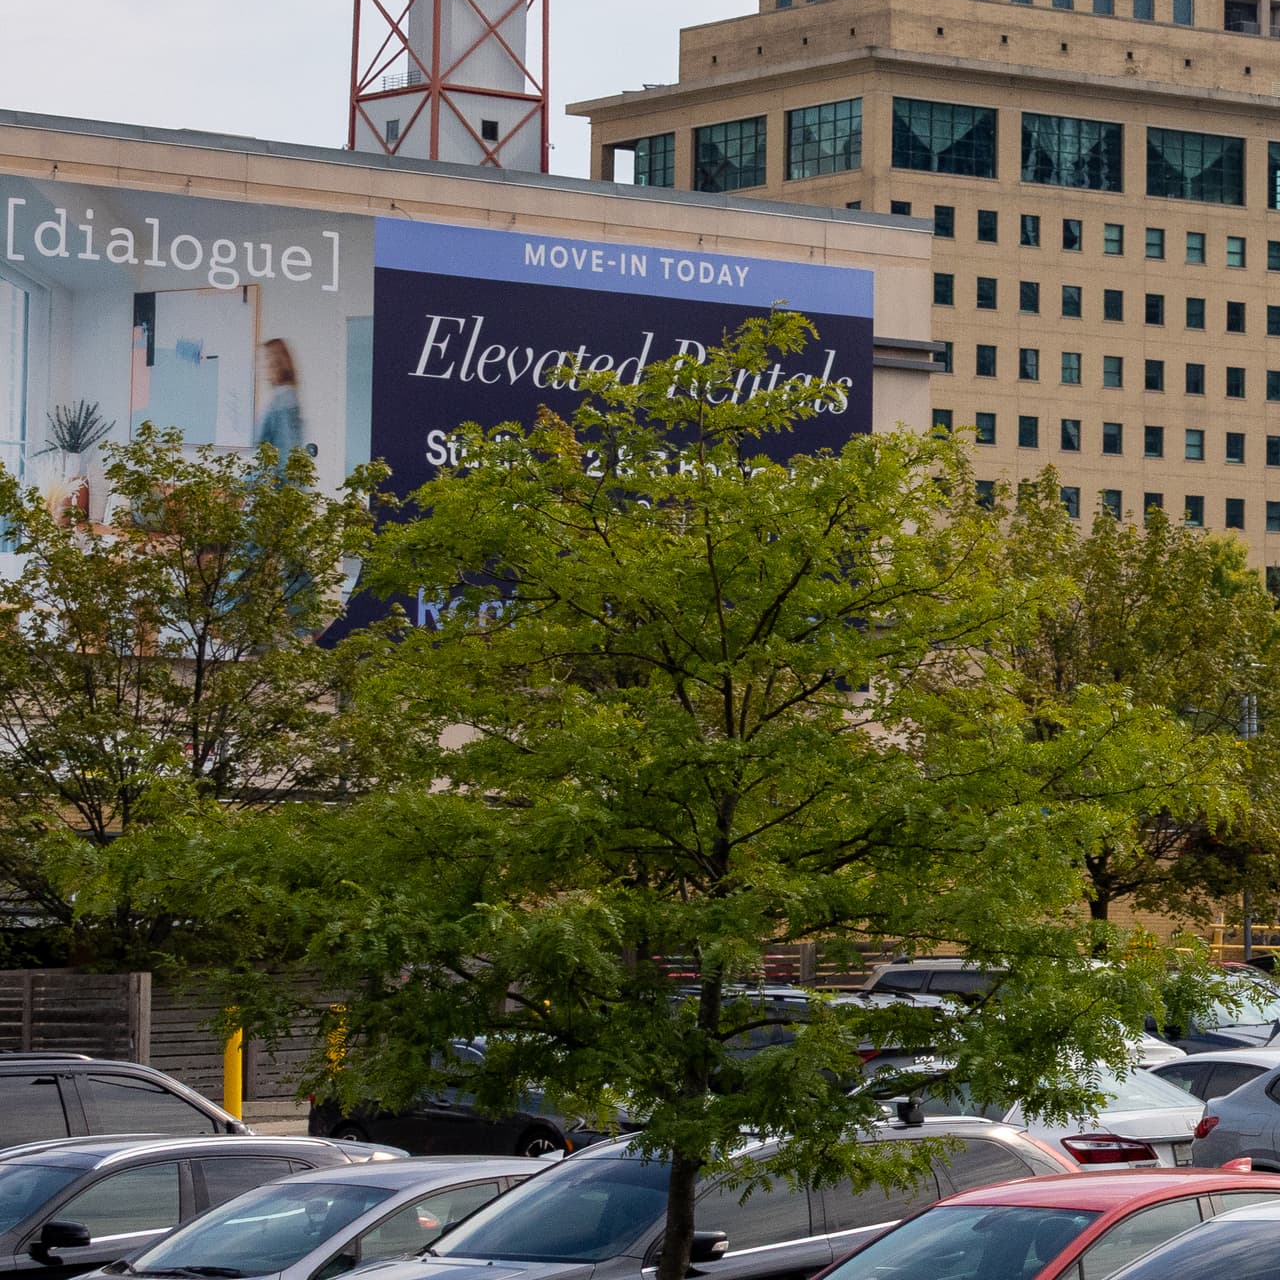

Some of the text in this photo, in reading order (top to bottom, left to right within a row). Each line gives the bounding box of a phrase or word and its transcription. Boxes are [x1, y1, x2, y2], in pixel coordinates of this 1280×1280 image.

[6, 197, 339, 292] [dialogue]
[525, 242, 749, 287] MOVE-IN TODAY
[408, 314, 654, 392] Elevated
